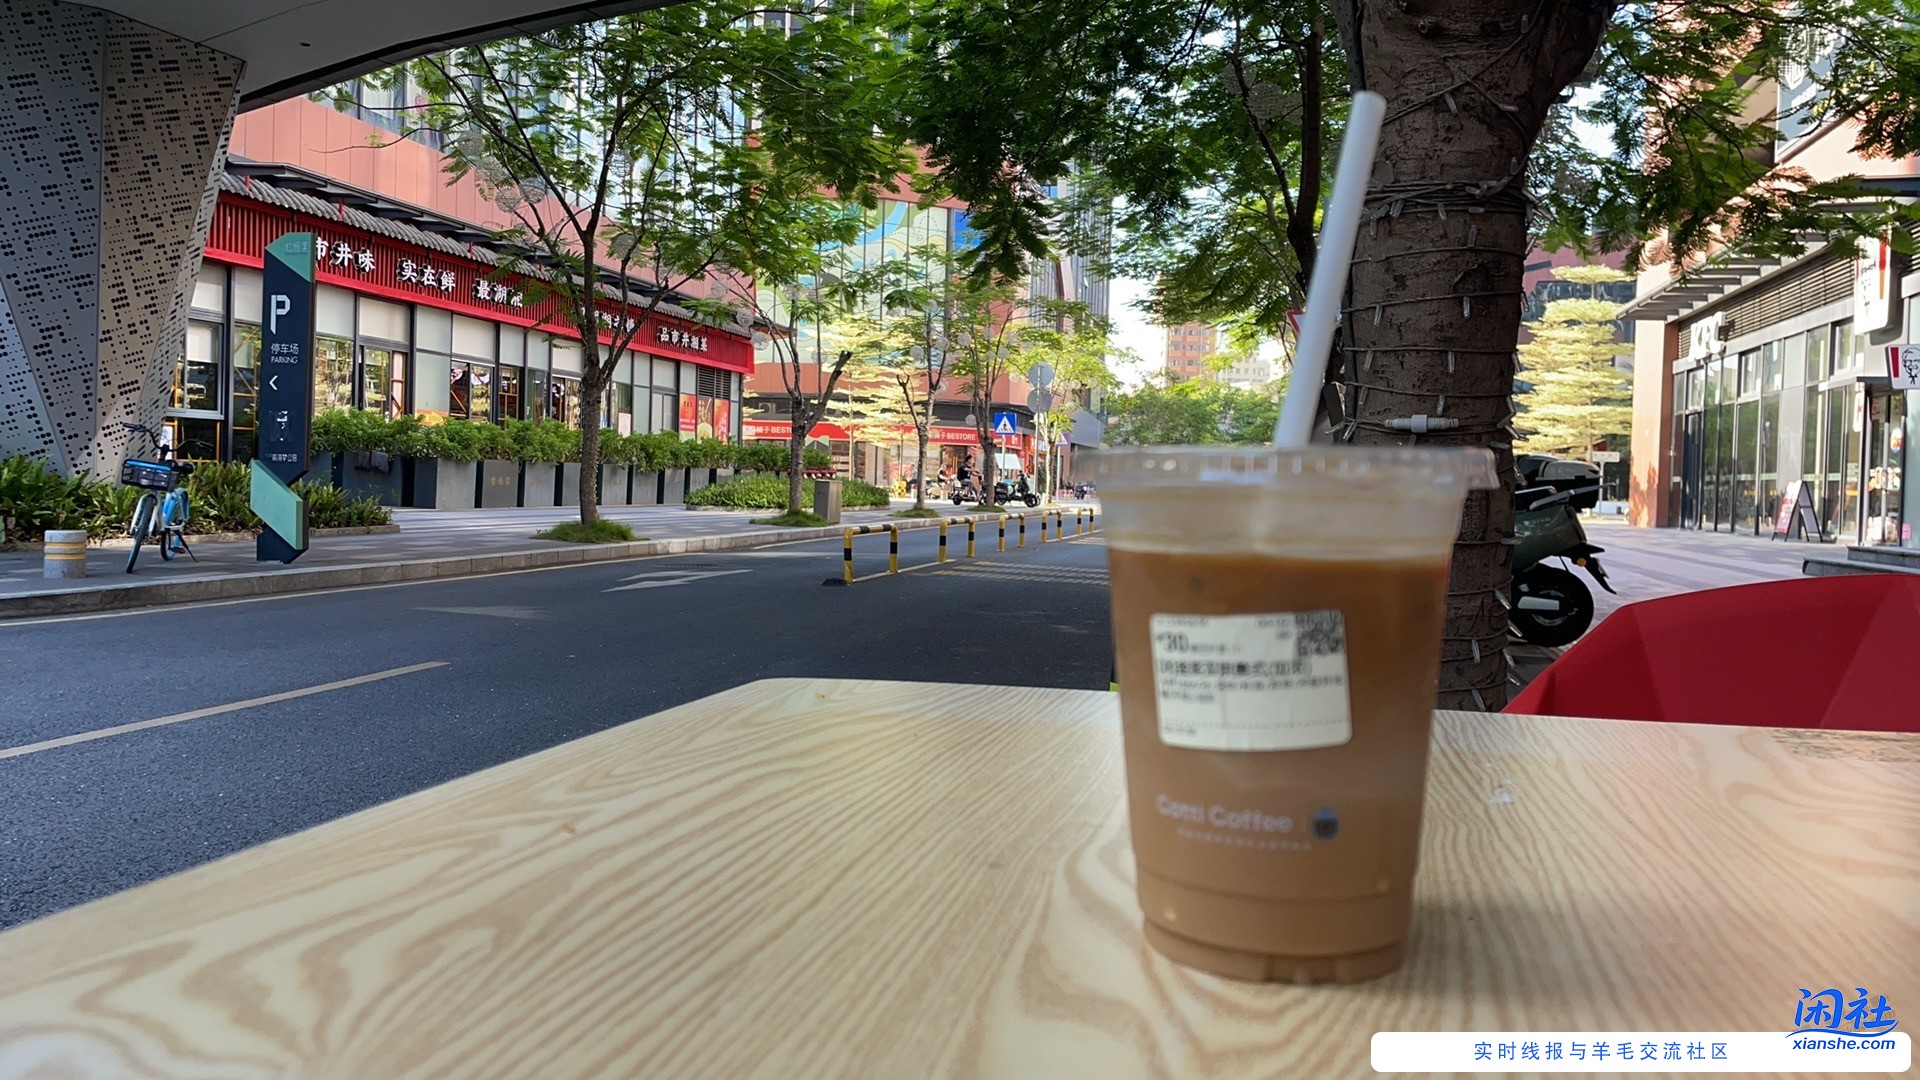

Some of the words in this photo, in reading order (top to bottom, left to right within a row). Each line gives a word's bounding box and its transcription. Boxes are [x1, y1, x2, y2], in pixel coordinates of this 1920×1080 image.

[316, 237, 375, 273] 市井味
[401, 260, 455, 292] 实在鲜
[270, 294, 291, 335] P
[271, 343, 299, 355] 停车场
[660, 326, 708, 352] 品市井湘菜
[1687, 311, 1727, 363] KFC
[271, 356, 298, 364] PARKING
[947, 431, 976, 441] BESTORE
[1208, 805, 1293, 833] Coffee
